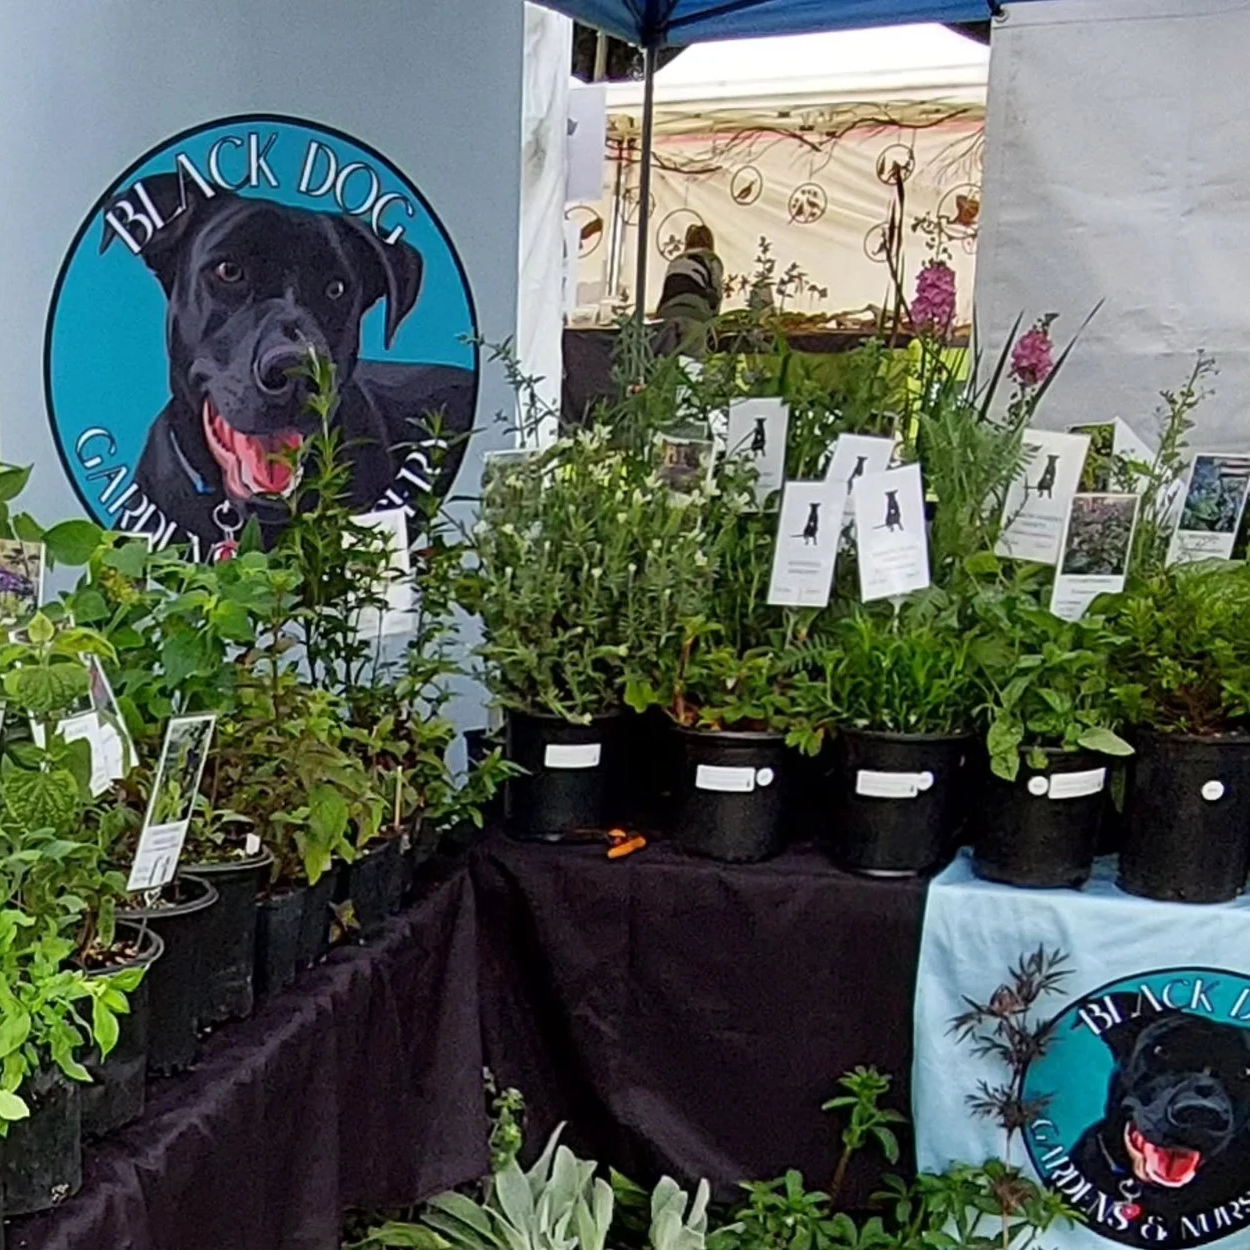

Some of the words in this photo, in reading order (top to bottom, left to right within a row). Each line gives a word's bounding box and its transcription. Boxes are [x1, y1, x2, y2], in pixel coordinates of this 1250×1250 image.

[105, 134, 279, 254] BLACK
[299, 141, 414, 245] DOG
[1078, 979, 1219, 1036] BLACK
[1032, 1119, 1129, 1231] GARDENS
[1140, 1215, 1168, 1241] &
[1181, 1190, 1250, 1240] NURS
